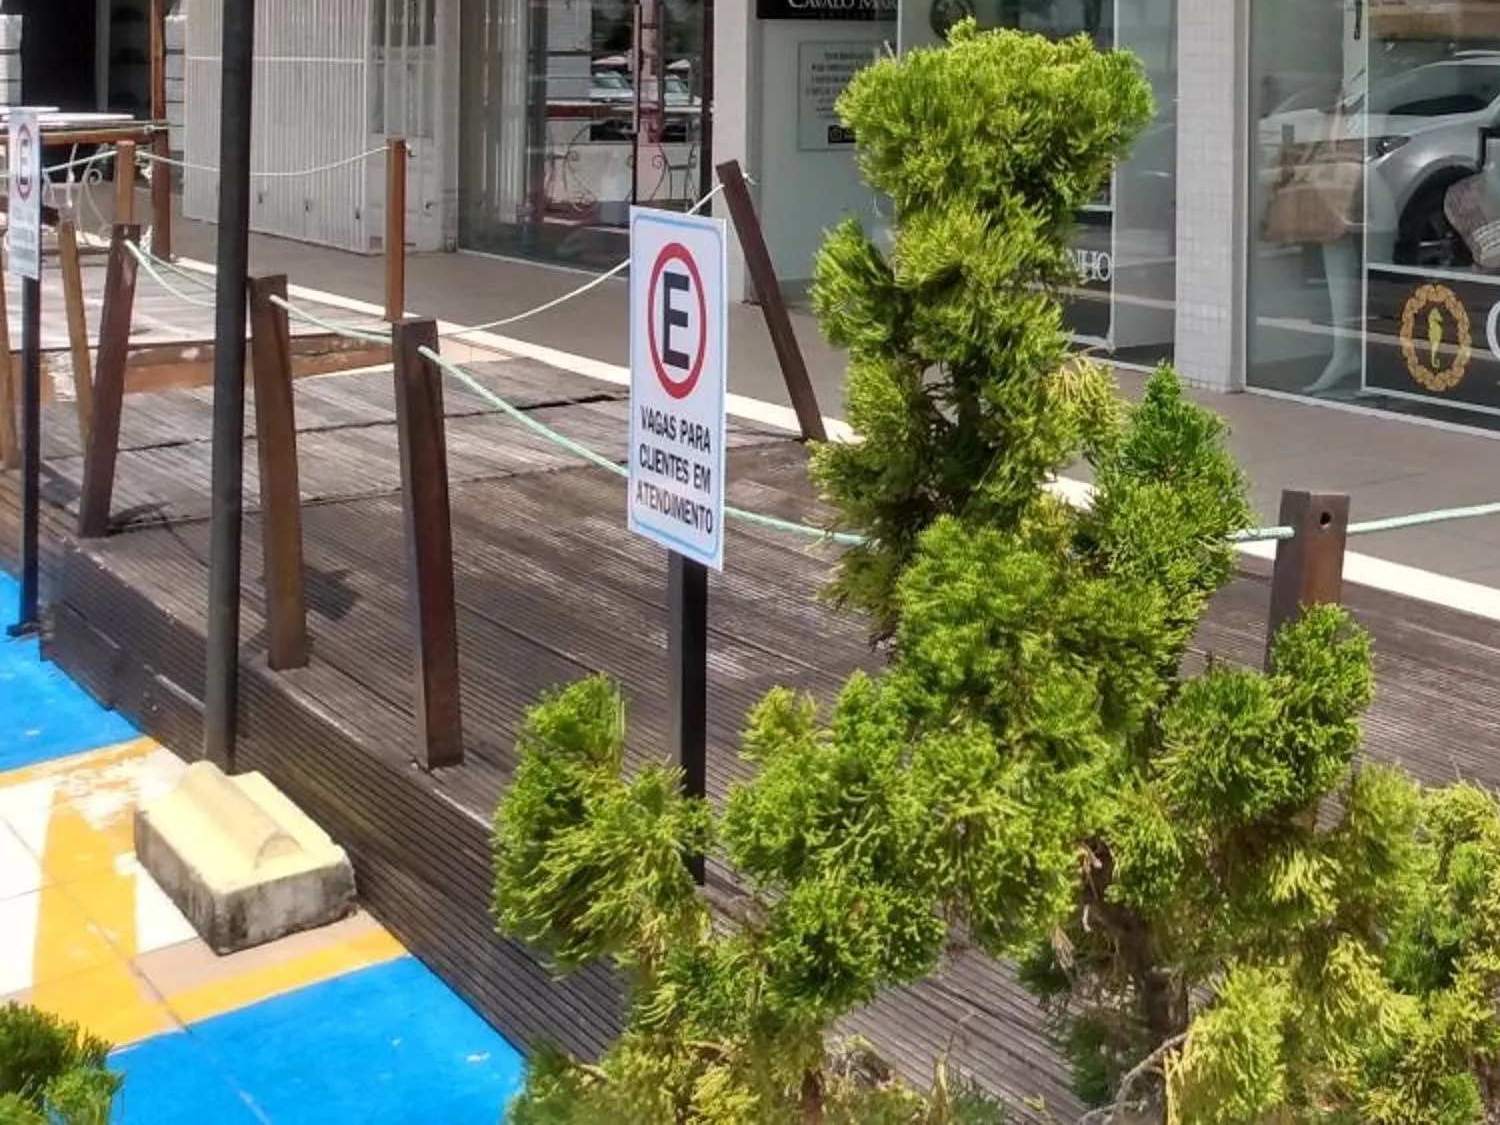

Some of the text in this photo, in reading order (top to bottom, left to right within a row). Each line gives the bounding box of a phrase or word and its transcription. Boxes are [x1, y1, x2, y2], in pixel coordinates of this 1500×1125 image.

[662, 270, 690, 370] E
[639, 405, 711, 455] VAGAS PARA
[639, 442, 711, 495] CLIENTES EM
[635, 478, 712, 535] ATENDIMENTO
